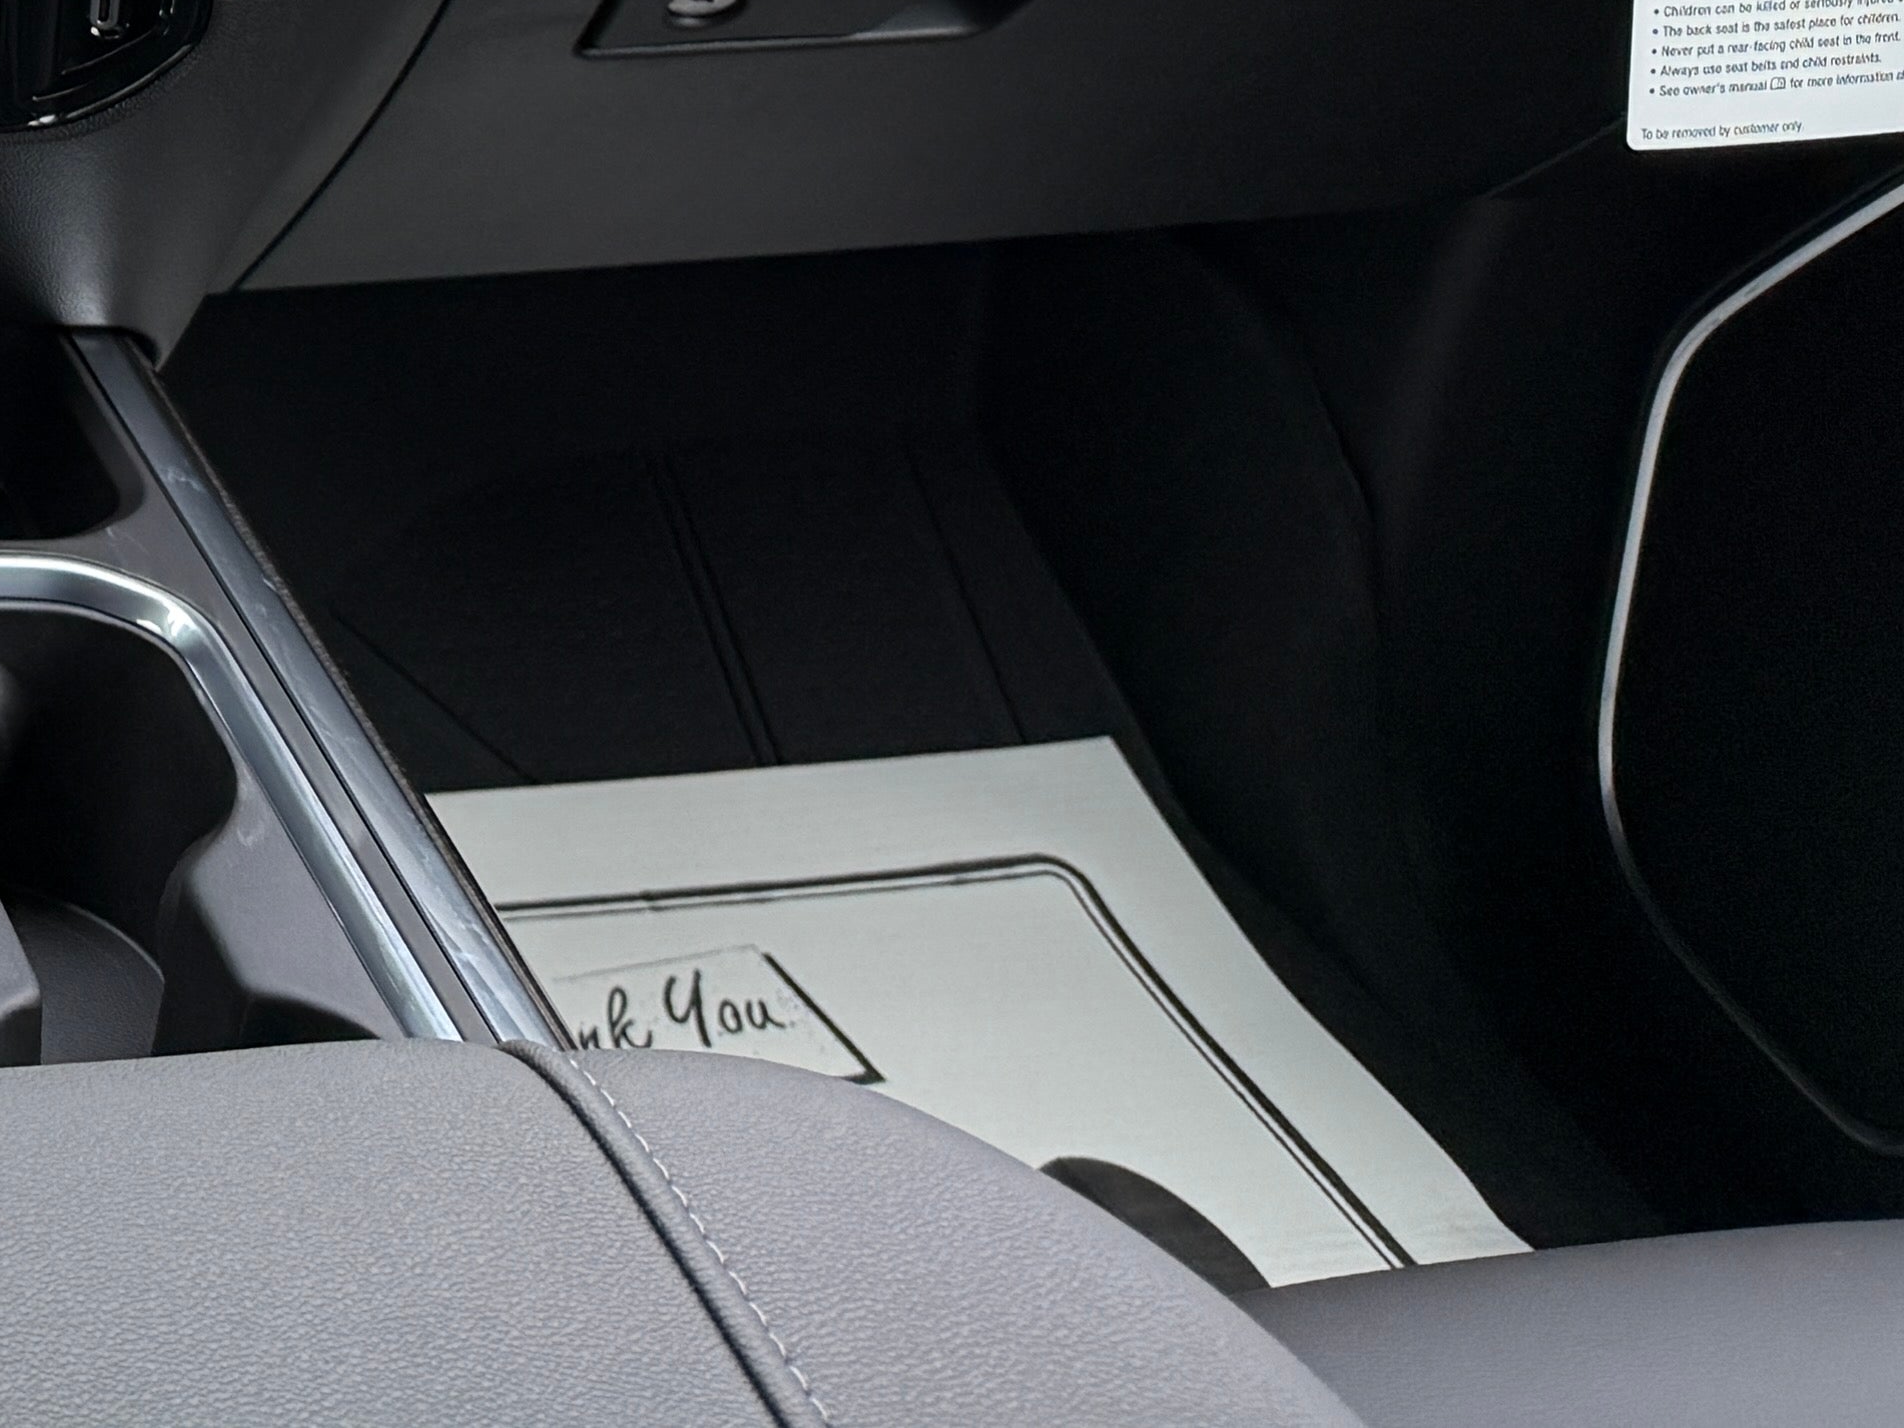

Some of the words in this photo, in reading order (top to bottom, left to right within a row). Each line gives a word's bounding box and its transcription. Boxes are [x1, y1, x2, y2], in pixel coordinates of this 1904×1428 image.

[1663, 4, 1711, 18] Children
[1715, 2, 1735, 14] can
[1663, 25, 1683, 38] The
[1686, 24, 1712, 36] back
[1662, 45, 1693, 57] Never
[1697, 43, 1715, 59] put
[1660, 64, 1700, 78] Always
[1641, 127, 1654, 140] To
[664, 968, 787, 1049] You
